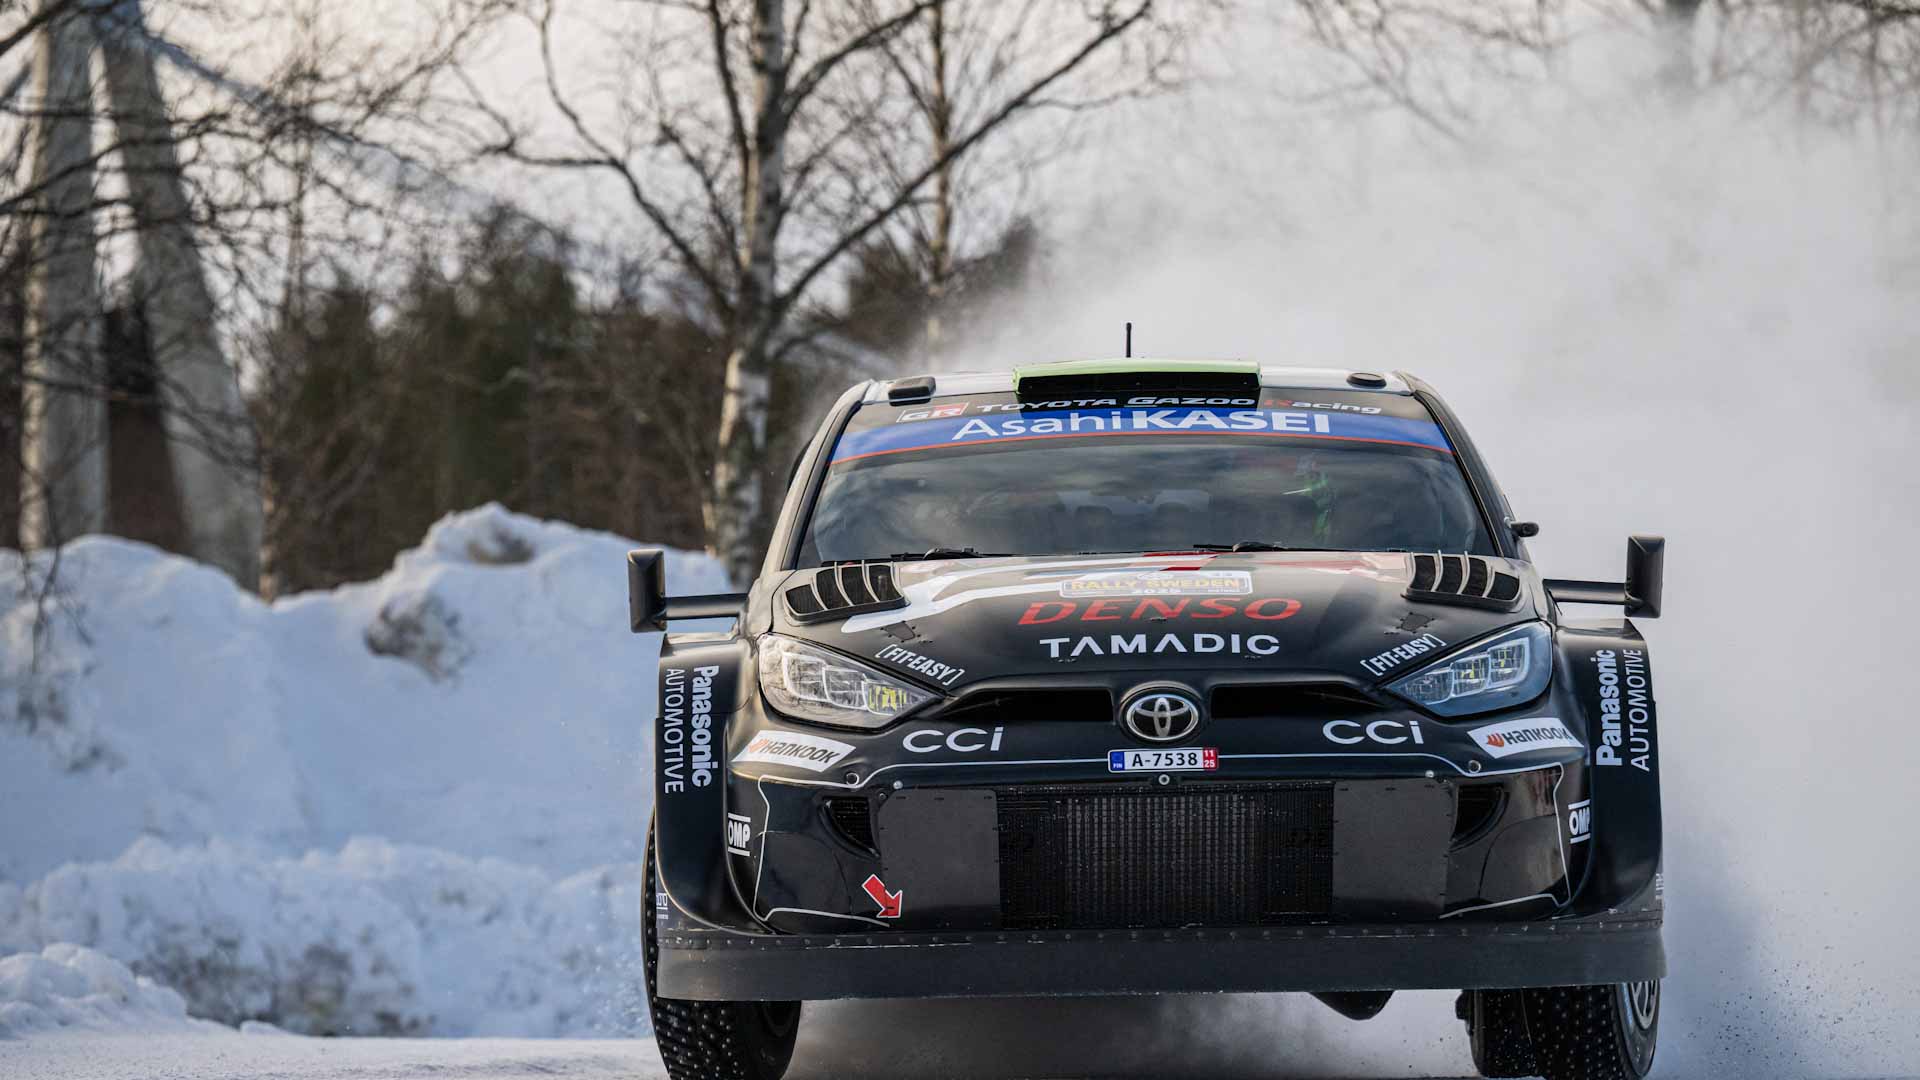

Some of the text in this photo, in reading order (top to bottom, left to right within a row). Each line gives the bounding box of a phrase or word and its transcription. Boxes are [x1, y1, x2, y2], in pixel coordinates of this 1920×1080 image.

[900, 406, 961, 421] GR
[977, 399, 1117, 413] TOYOTA
[1127, 396, 1256, 406] GAZOO
[1070, 578, 1240, 590] RALLY SWEDEN
[1018, 597, 1303, 625] DENSO
[1040, 633, 1280, 658] TAMADIC
[1590, 649, 1623, 767] Panasonic
[1623, 648, 1650, 772] AUTOMOTIVE
[664, 668, 685, 794] AUTOMOTIVE
[691, 665, 720, 787] Panasonic
[1132, 752, 1198, 767] A-7538
[1203, 749, 1215, 757] 11
[1203, 759, 1215, 768] 25
[1569, 805, 1591, 836] OMP
[728, 819, 751, 849] OMP
